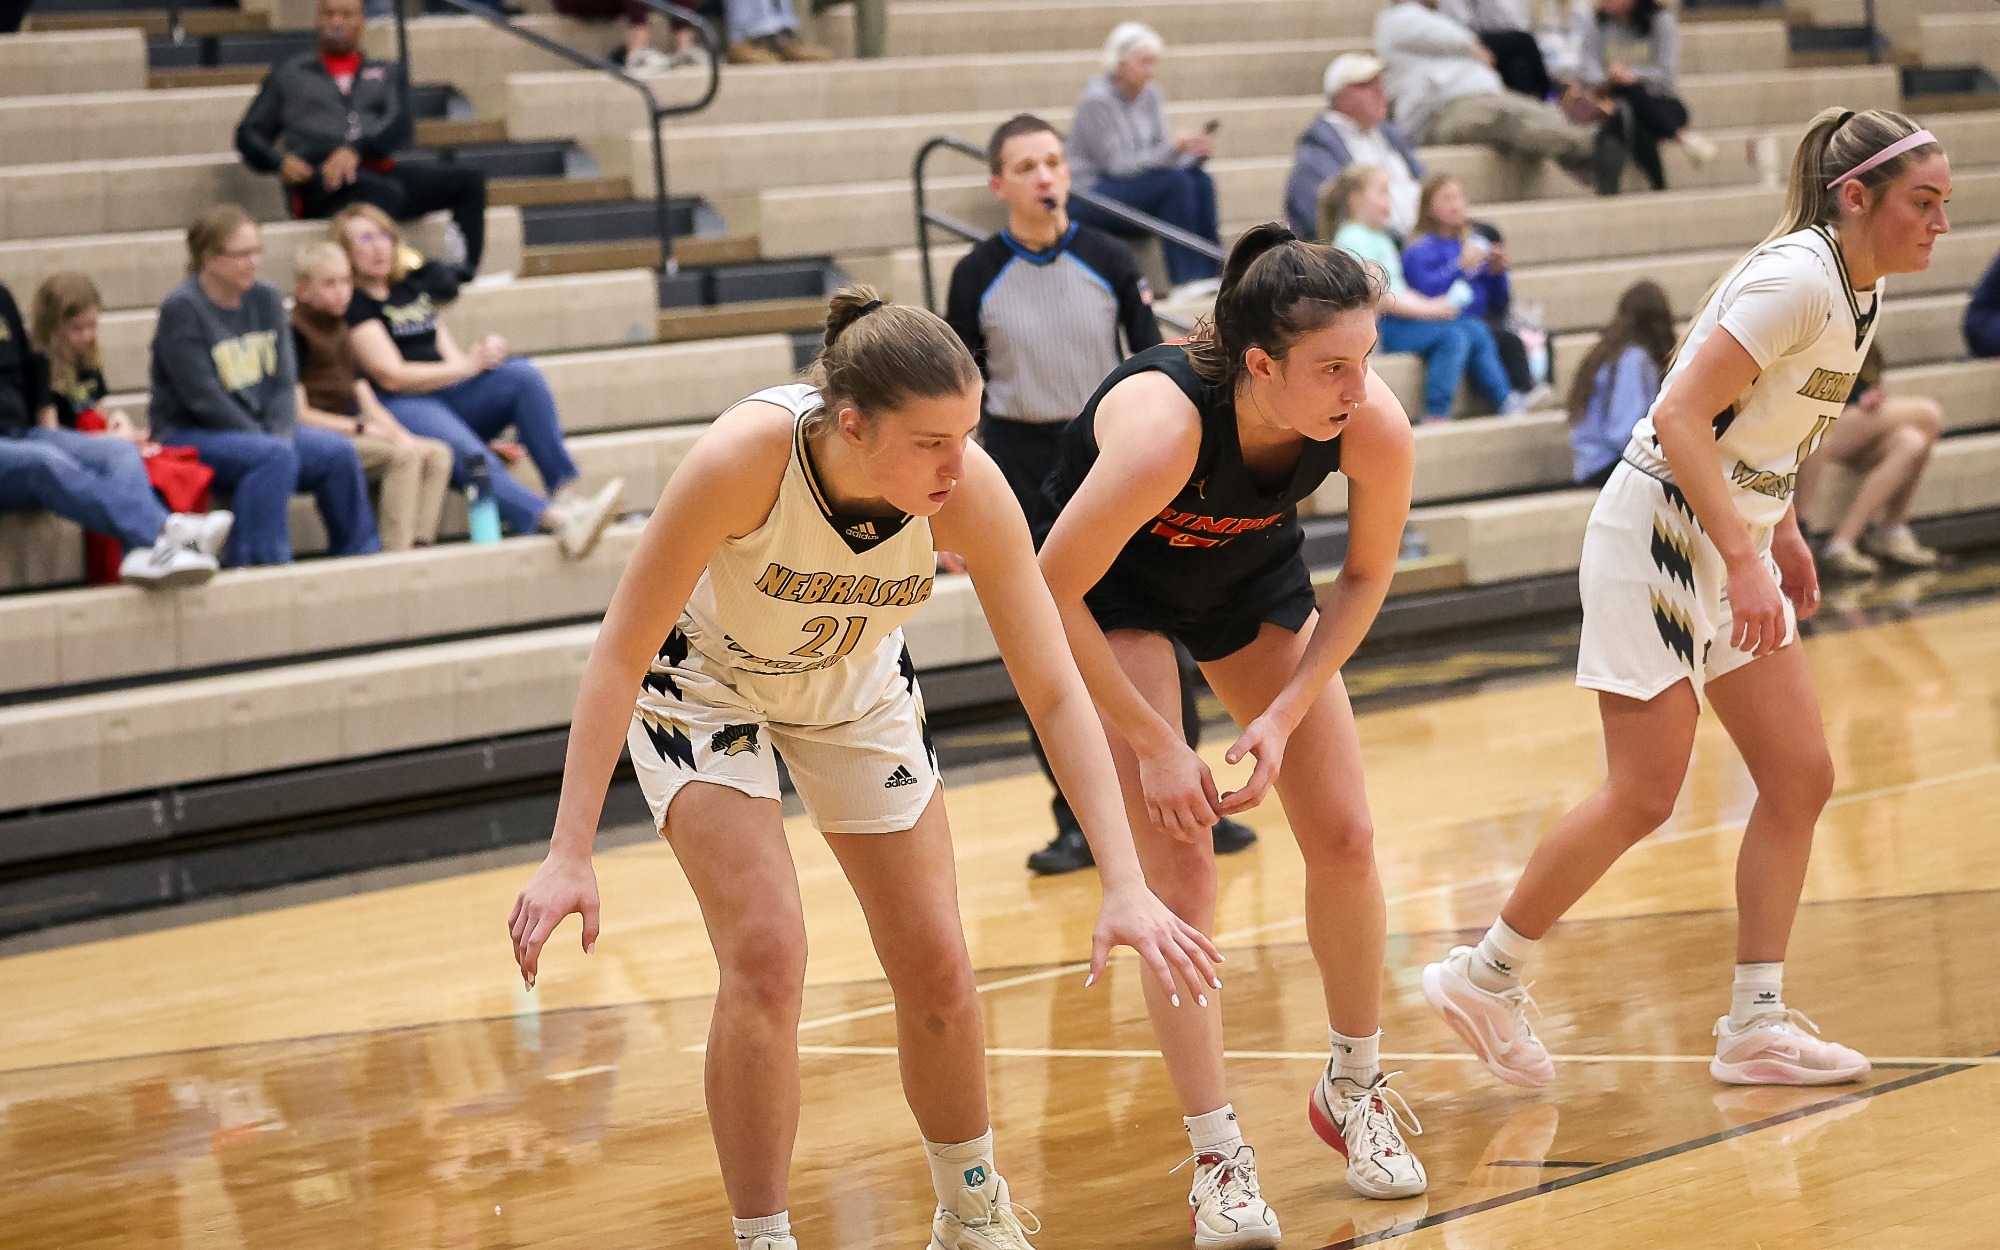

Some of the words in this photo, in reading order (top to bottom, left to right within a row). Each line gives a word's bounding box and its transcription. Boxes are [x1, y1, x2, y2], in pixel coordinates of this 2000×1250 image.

[845, 528, 879, 540] adidas
[753, 562, 935, 607] NEBRASKA
[788, 615, 868, 658] 21
[884, 777, 918, 789] adidas
